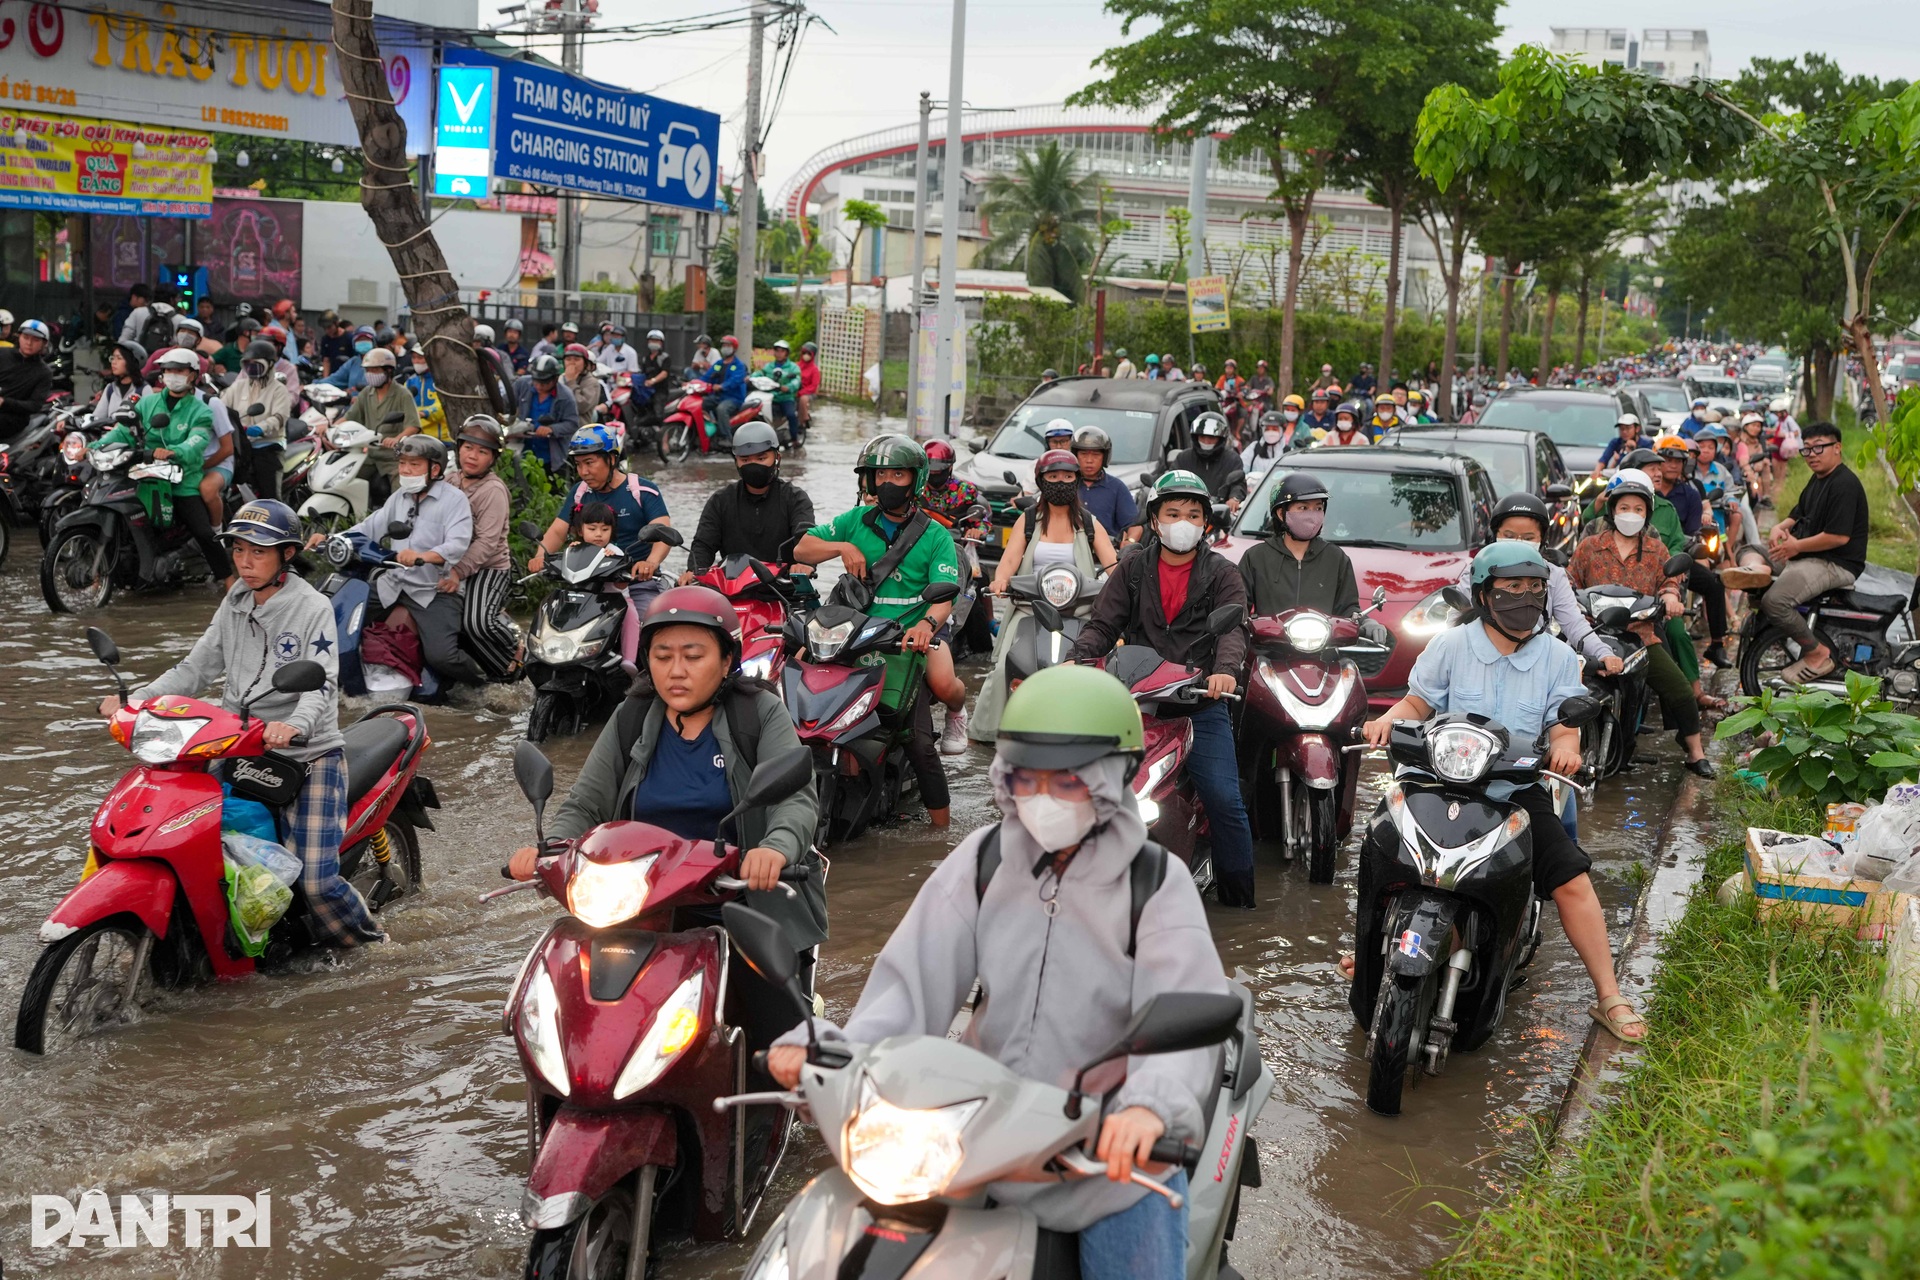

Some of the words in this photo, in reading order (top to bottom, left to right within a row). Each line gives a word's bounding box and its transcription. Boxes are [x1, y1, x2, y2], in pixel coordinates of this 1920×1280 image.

[202, 105, 217, 122] LH
[513, 76, 557, 113] TRẠM
[561, 88, 593, 121] SẠC
[596, 96, 626, 127] PHÚ
[628, 103, 650, 132] MỸ
[113, 126, 165, 146] KHÁCH
[166, 132, 209, 149] HÀNG
[444, 124, 484, 134] VINFAST
[86, 153, 118, 173] QUÀ
[510, 129, 590, 166] CHARGING
[593, 148, 649, 177] STATION
[80, 173, 121, 195] TẶNG
[233, 758, 283, 788] Yankees
[1445, 791, 1470, 800] HONDA
[600, 946, 636, 955] HONDA
[1213, 1113, 1239, 1183] VISION
